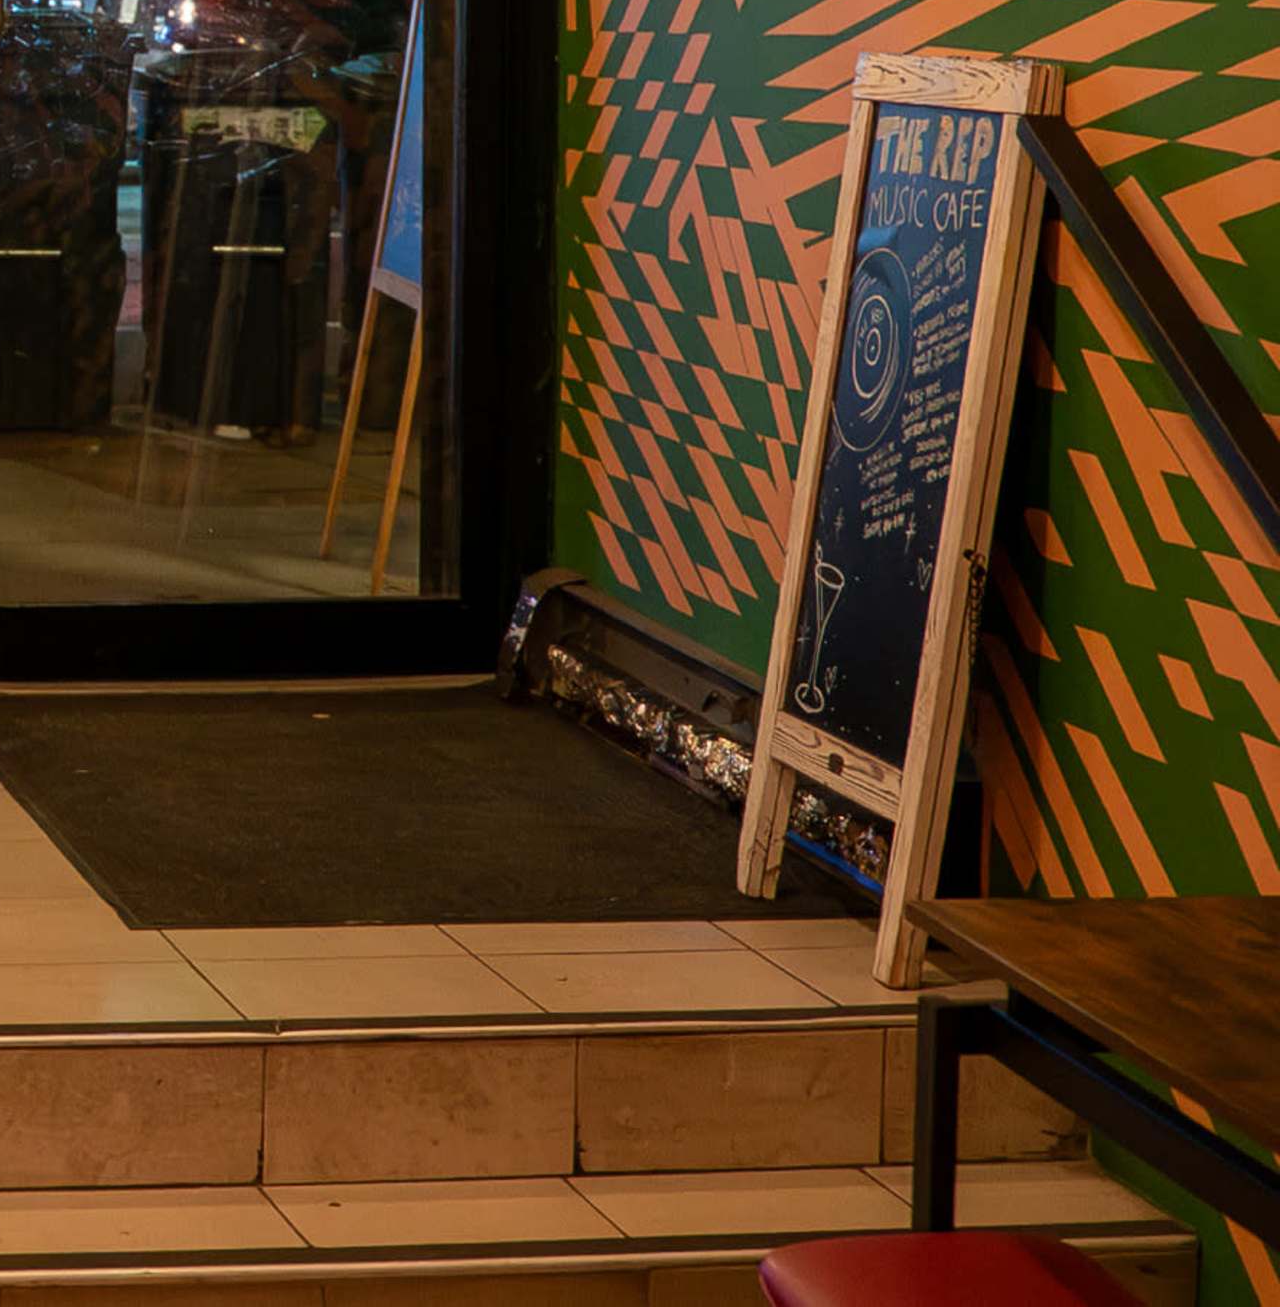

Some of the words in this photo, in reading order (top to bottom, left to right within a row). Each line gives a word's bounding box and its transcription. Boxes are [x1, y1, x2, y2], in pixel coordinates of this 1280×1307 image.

[876, 115, 930, 175] THE
[929, 115, 995, 185] REP
[868, 183, 928, 228] MUSIC
[933, 188, 989, 232] CAFE
